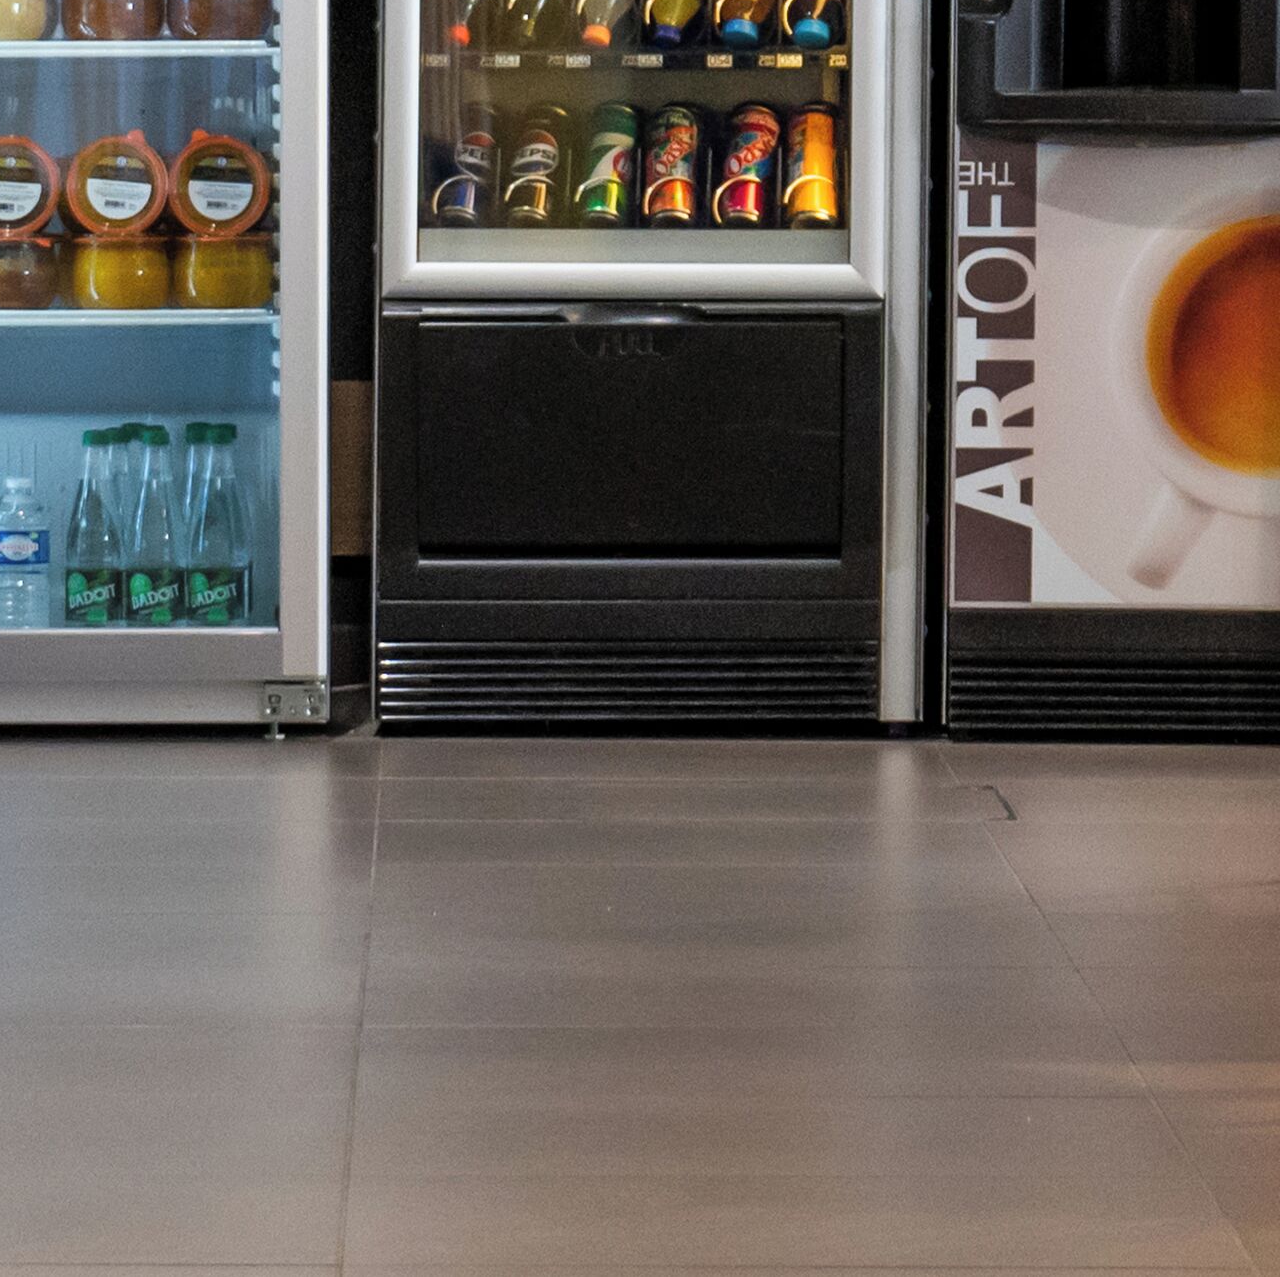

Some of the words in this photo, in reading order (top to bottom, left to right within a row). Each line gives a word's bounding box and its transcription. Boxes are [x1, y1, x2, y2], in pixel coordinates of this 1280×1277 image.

[958, 159, 1016, 186] THE
[956, 190, 1037, 315] OF
[953, 317, 1036, 530] ART
